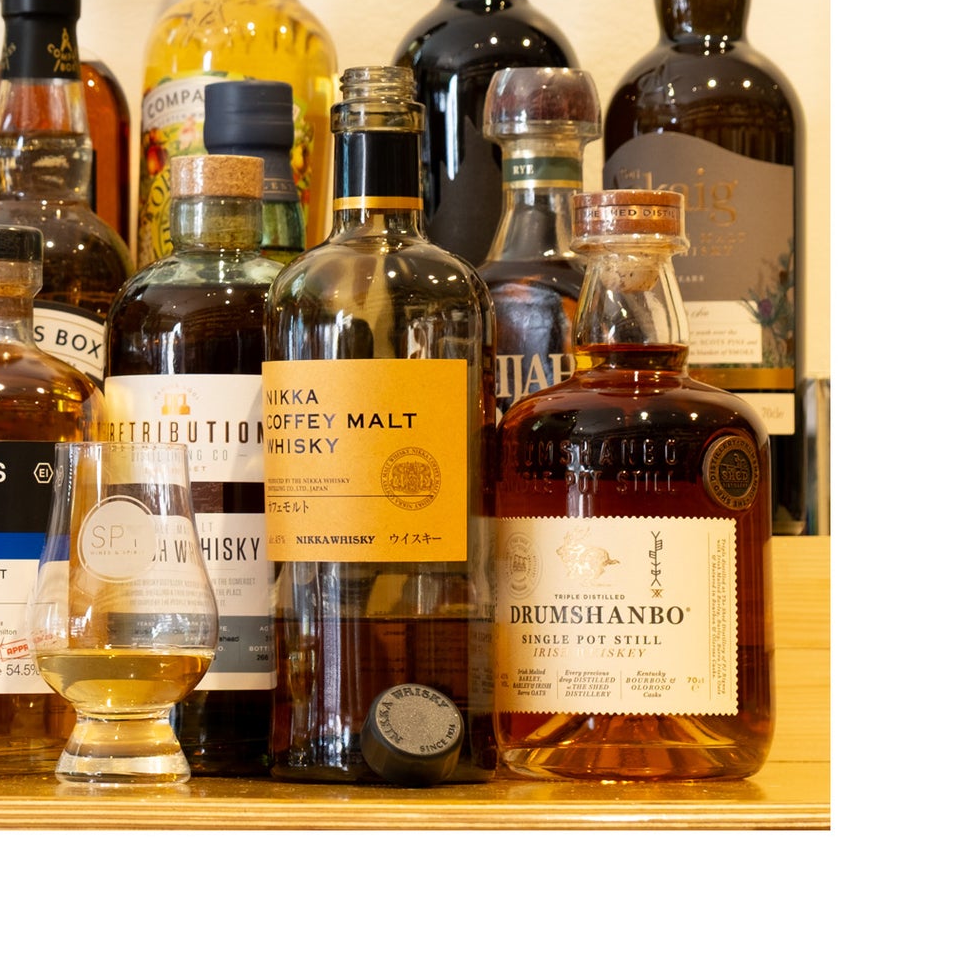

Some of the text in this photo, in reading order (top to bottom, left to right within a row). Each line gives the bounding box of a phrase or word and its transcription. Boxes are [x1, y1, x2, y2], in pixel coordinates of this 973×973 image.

[147, 89, 205, 119] COMPA
[512, 164, 534, 175] RYE
[643, 210, 674, 218] DISTIL
[55, 327, 102, 359] BOX
[267, 389, 319, 405] NIKKA
[267, 413, 417, 429] COFFEY MALT
[267, 438, 339, 454] WHISKY
[212, 449, 229, 461] CO
[617, 470, 676, 494] STILL
[389, 532, 442, 545] ウイスキー
[521, 634, 662, 645] SINGLE POT STILL
[391, 687, 449, 709] WHISKY
[419, 738, 448, 753] SINCE
